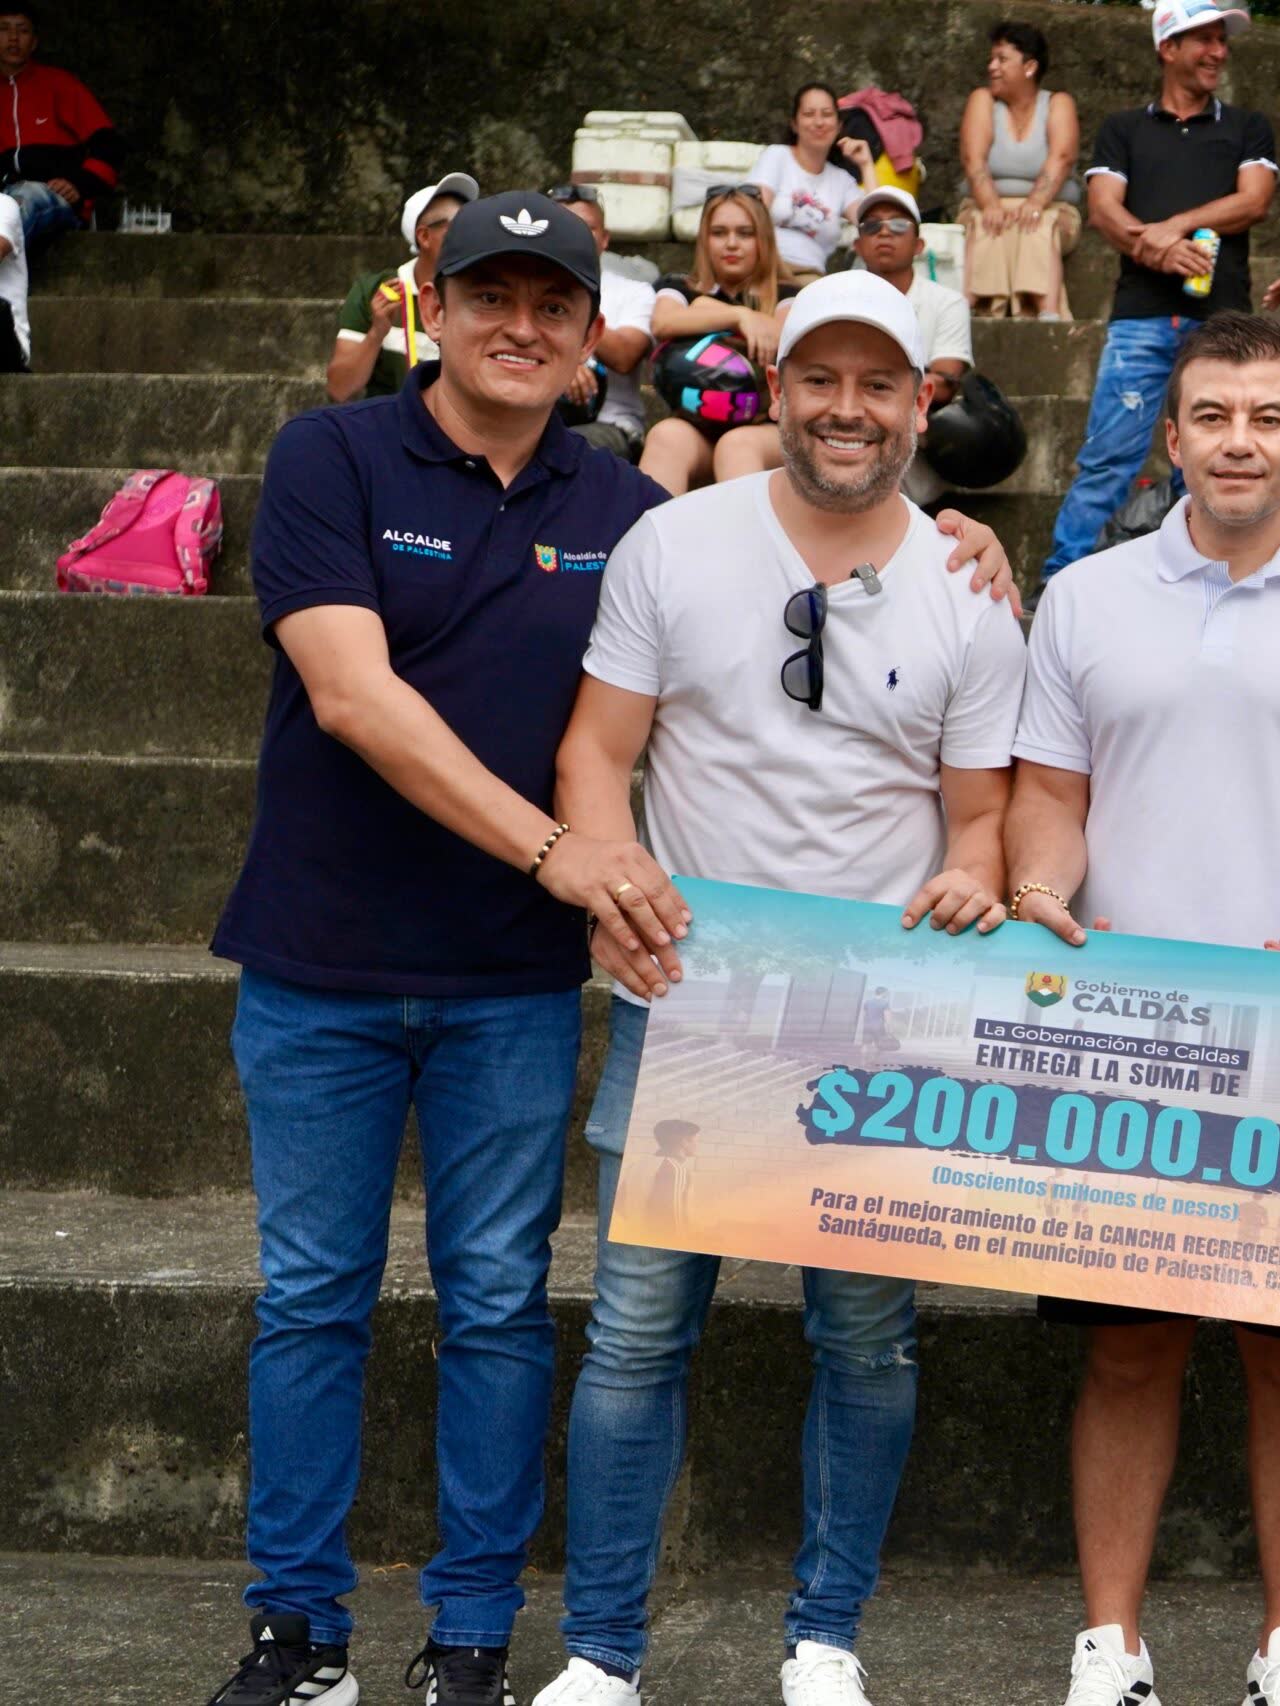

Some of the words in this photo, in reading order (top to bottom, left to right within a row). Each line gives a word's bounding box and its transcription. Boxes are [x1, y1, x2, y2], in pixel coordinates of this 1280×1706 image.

[382, 529, 452, 551] ALCALDE
[392, 543, 405, 551] DE
[406, 545, 452, 560] PALESTINA
[597, 551, 607, 560] de
[565, 561, 607, 571] PALEST
[1074, 980, 1162, 1000] Gobierno
[1165, 989, 1189, 1003] de
[1072, 993, 1211, 1026] CALDAS
[984, 1022, 1006, 1037] La
[1011, 1026, 1138, 1051] Gobernación
[1143, 1041, 1168, 1056] de
[1174, 1046, 1240, 1065] Caldas
[976, 1044, 1081, 1078] ENTREGA
[1091, 1058, 1119, 1083] LA
[1129, 1062, 1200, 1092] SUMA
[1210, 1072, 1240, 1097] DE
[932, 1166, 1047, 1196] (Doscientos
[1052, 1183, 1137, 1207] millones
[1142, 1194, 1165, 1211] de
[1171, 1198, 1239, 1221] pesos)
[810, 1188, 858, 1211] Para
[863, 1196, 883, 1214] el
[888, 1199, 1036, 1235] mejoramiento
[1041, 1218, 1069, 1238] de
[1074, 1221, 1094, 1241] la
[1099, 1223, 1176, 1251] CANCHA
[818, 1213, 947, 1250] Santágueda,
[954, 1233, 980, 1252] en
[986, 1236, 1006, 1255] el
[1011, 1240, 1117, 1269] municipio
[1123, 1252, 1148, 1273] de
